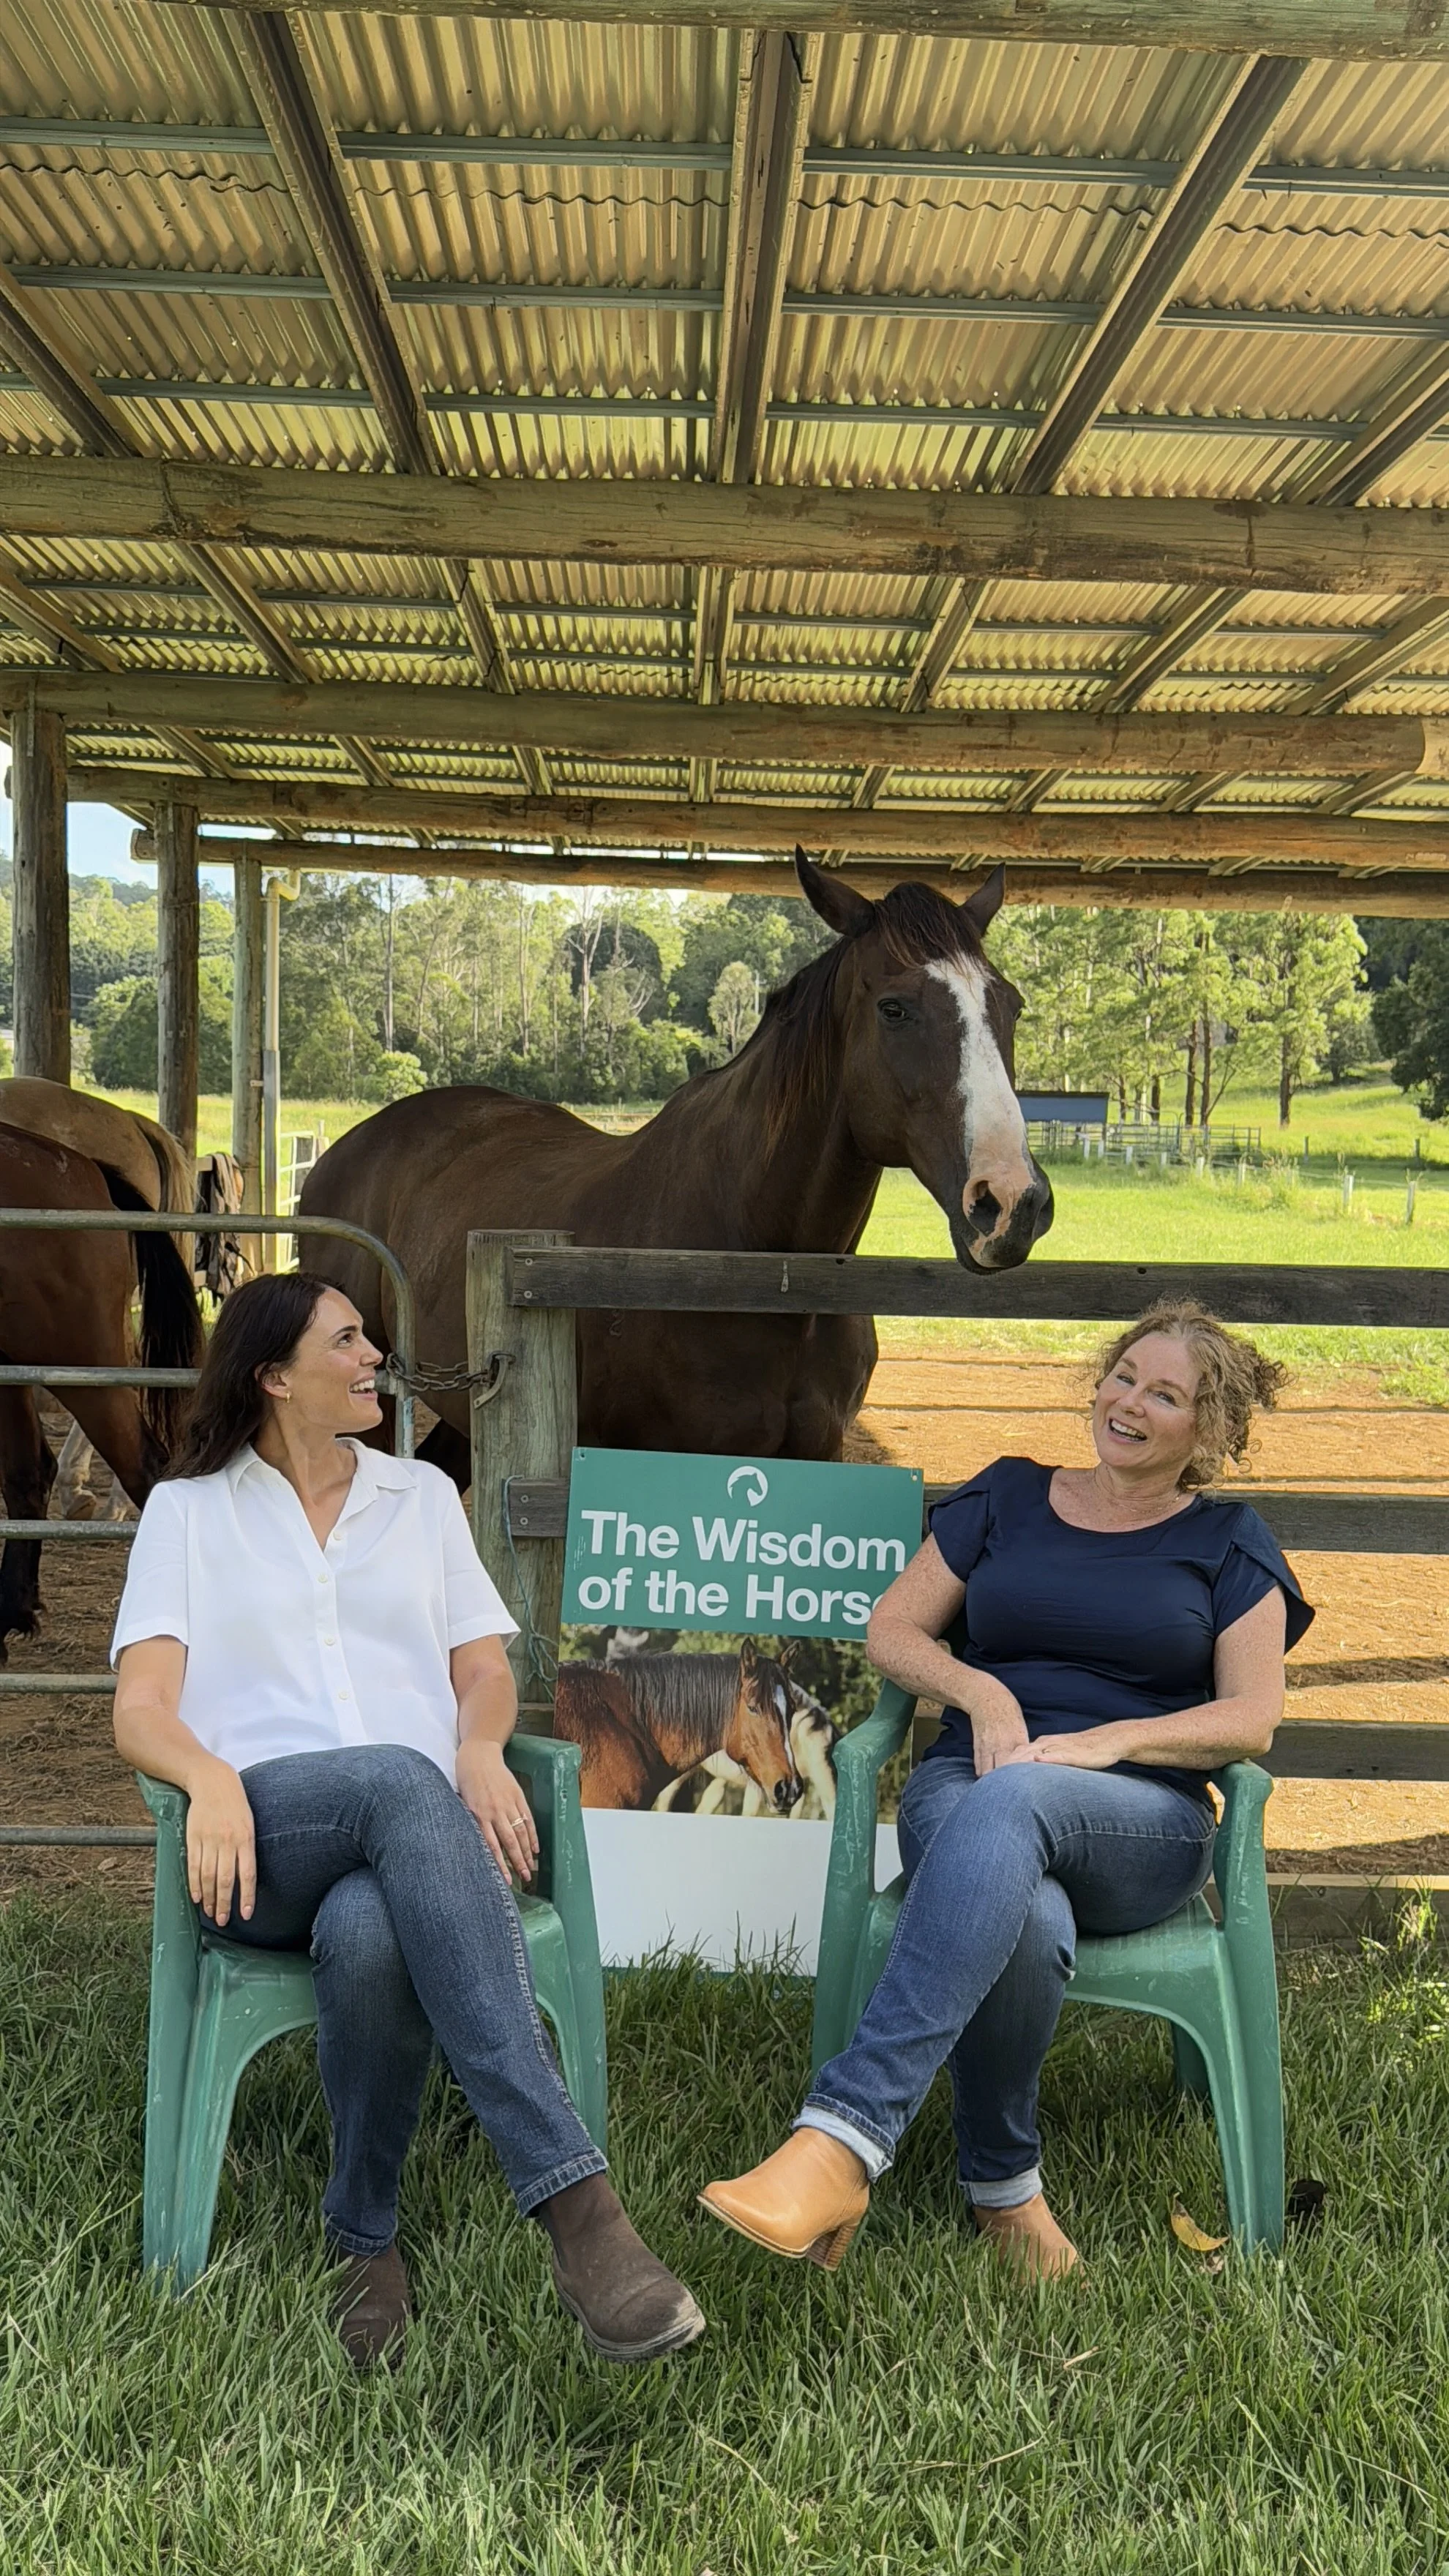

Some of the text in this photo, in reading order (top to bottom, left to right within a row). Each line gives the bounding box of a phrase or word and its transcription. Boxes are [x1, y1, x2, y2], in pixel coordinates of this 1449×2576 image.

[581, 1510, 905, 1572] The Wisdom
[578, 1567, 884, 1625] of the Hors
